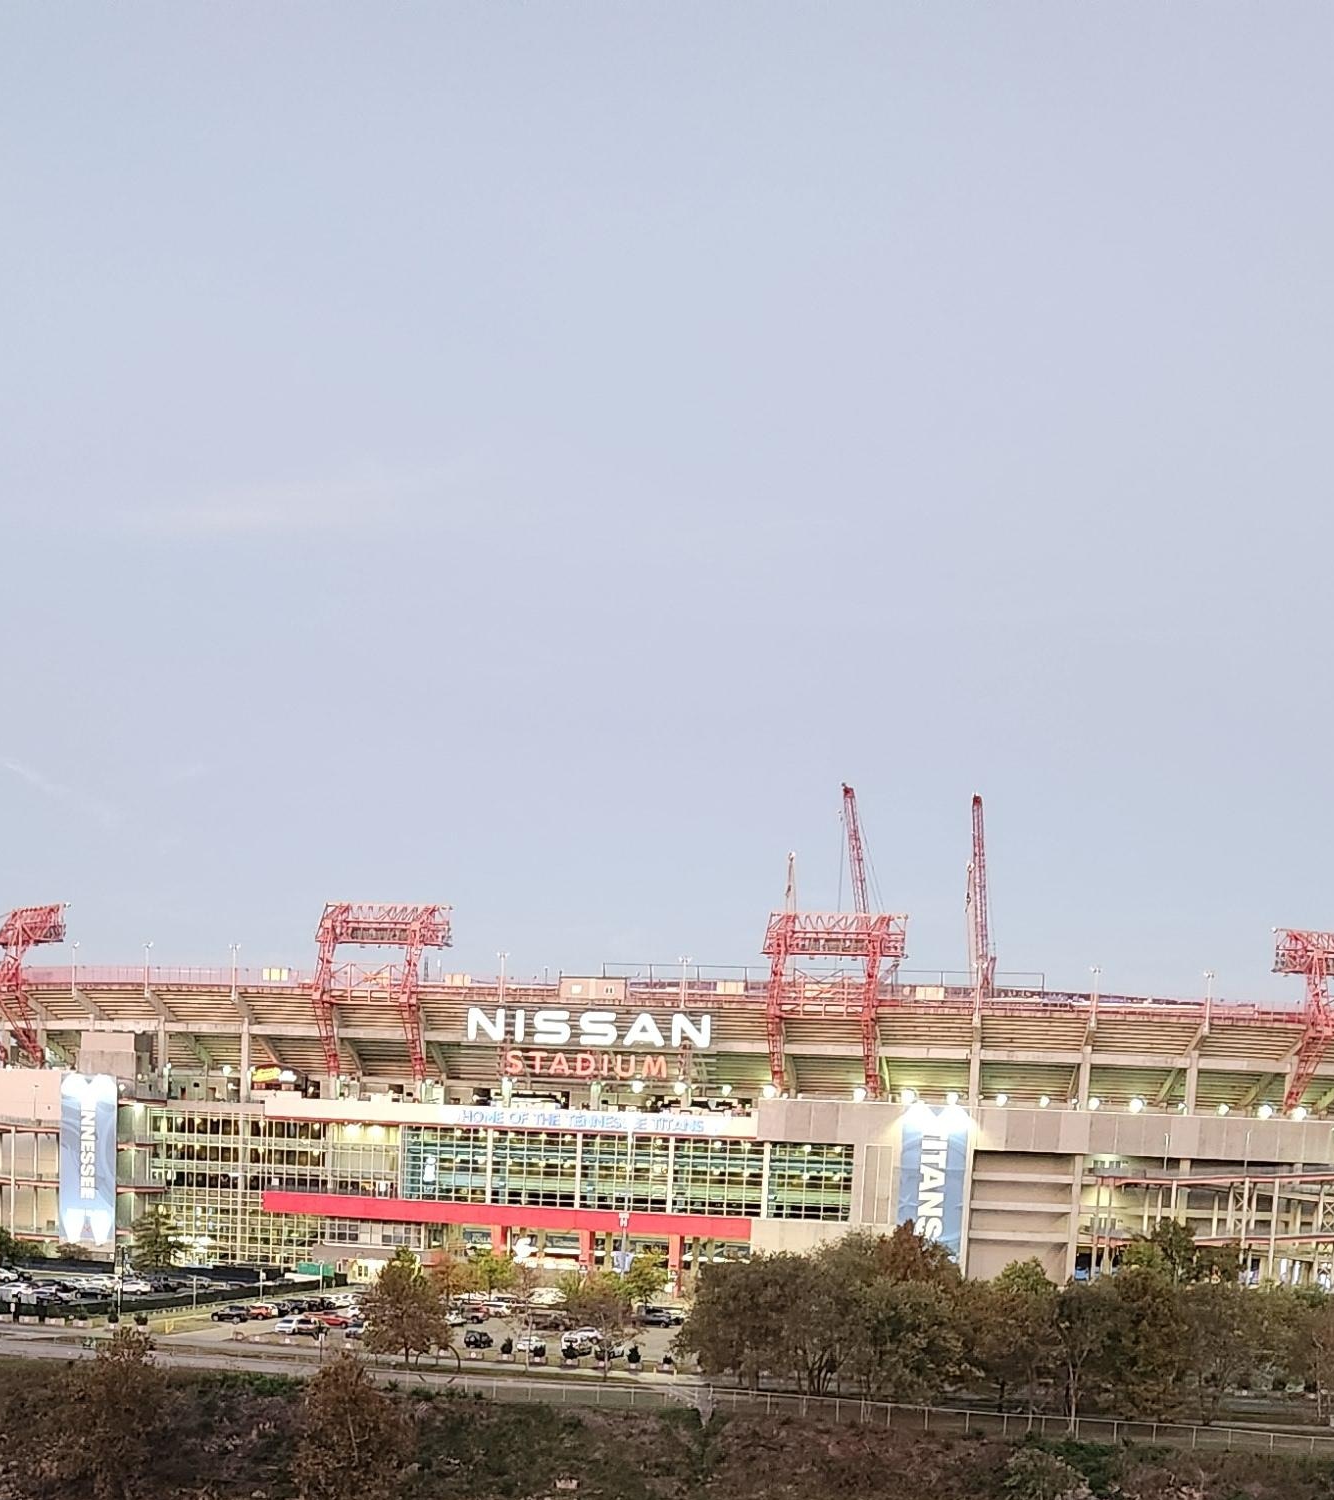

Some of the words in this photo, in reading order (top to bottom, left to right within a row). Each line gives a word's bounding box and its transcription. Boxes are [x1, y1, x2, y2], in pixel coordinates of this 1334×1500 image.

[467, 1006, 712, 1048] NISSAN
[505, 1049, 668, 1079] STADIUM
[461, 1109, 505, 1125] HOME
[509, 1112, 530, 1126] OF
[533, 1112, 562, 1127] THE
[565, 1113, 648, 1131] TENNESE
[652, 1118, 706, 1133] TITANS
[80, 1087, 97, 1200] NNESSEE
